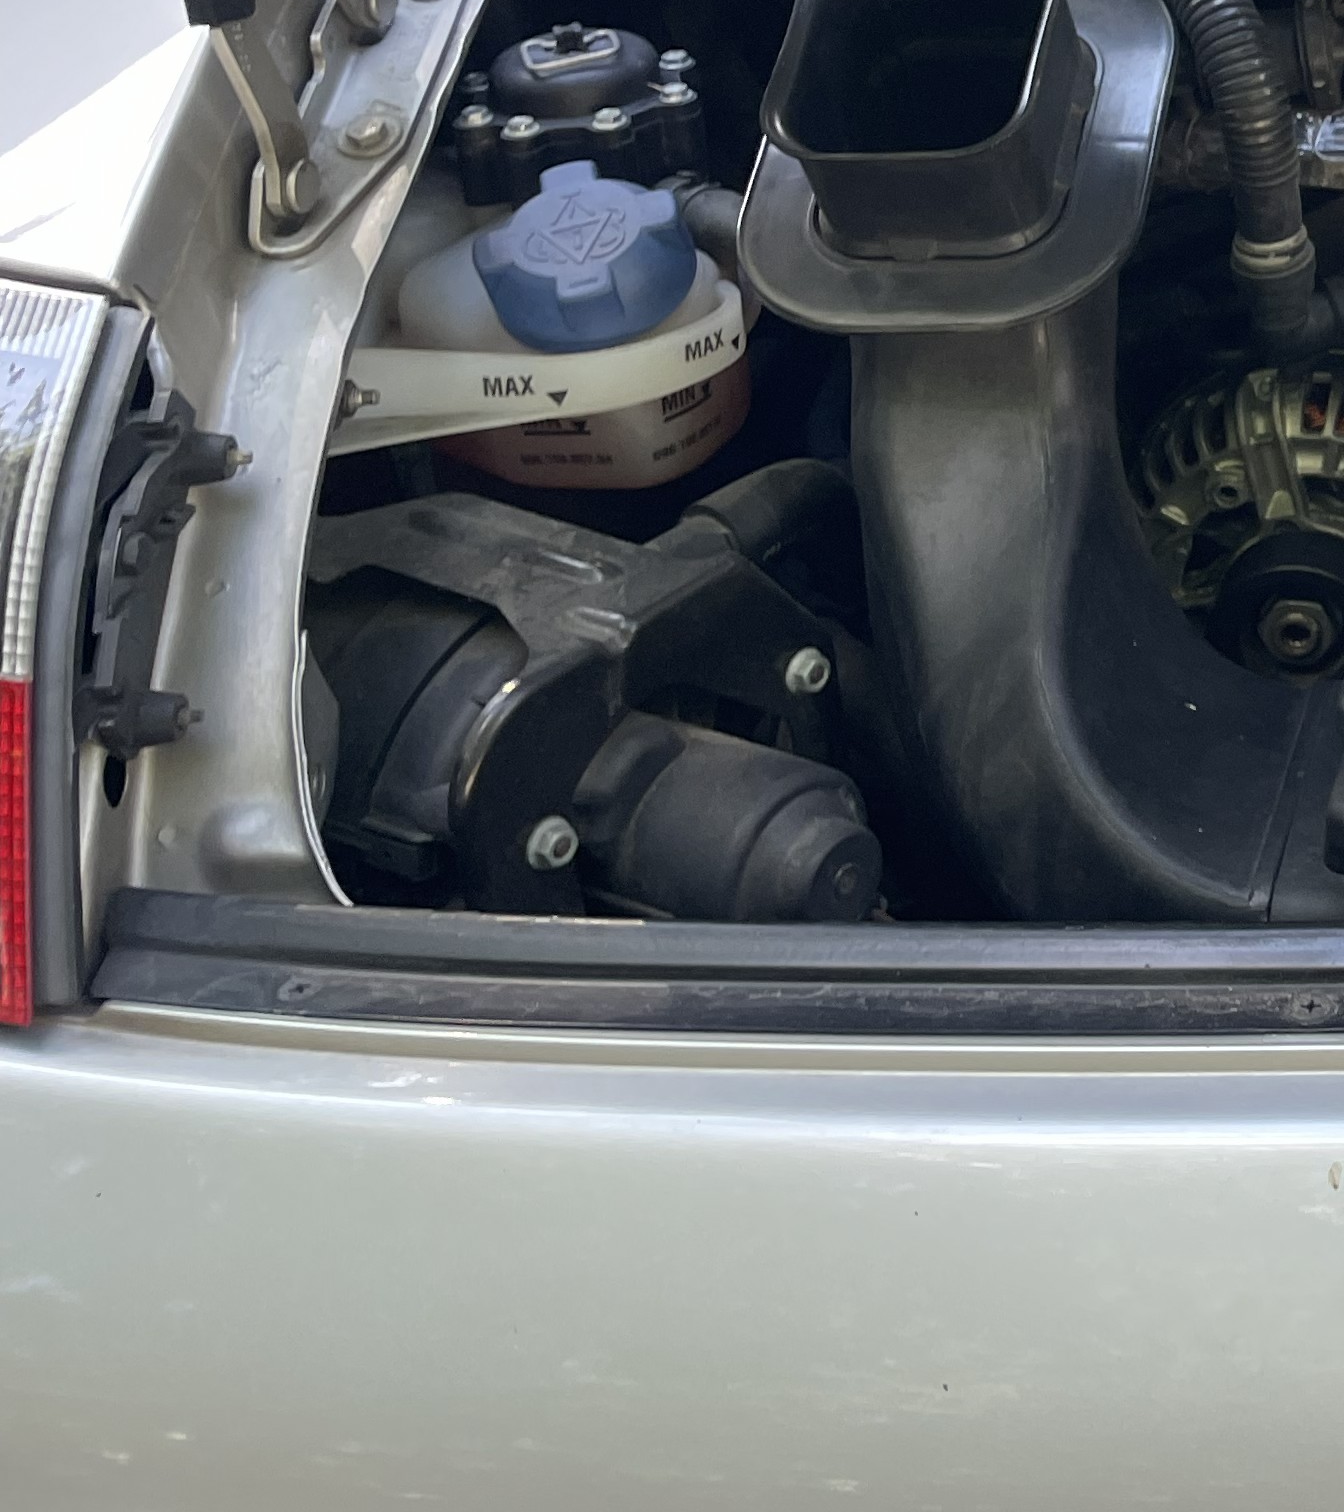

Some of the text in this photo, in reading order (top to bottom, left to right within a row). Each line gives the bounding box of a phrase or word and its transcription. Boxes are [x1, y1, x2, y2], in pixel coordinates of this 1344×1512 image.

[684, 328, 726, 363] MAX
[482, 375, 535, 398] MAX
[660, 386, 698, 416] MIN
